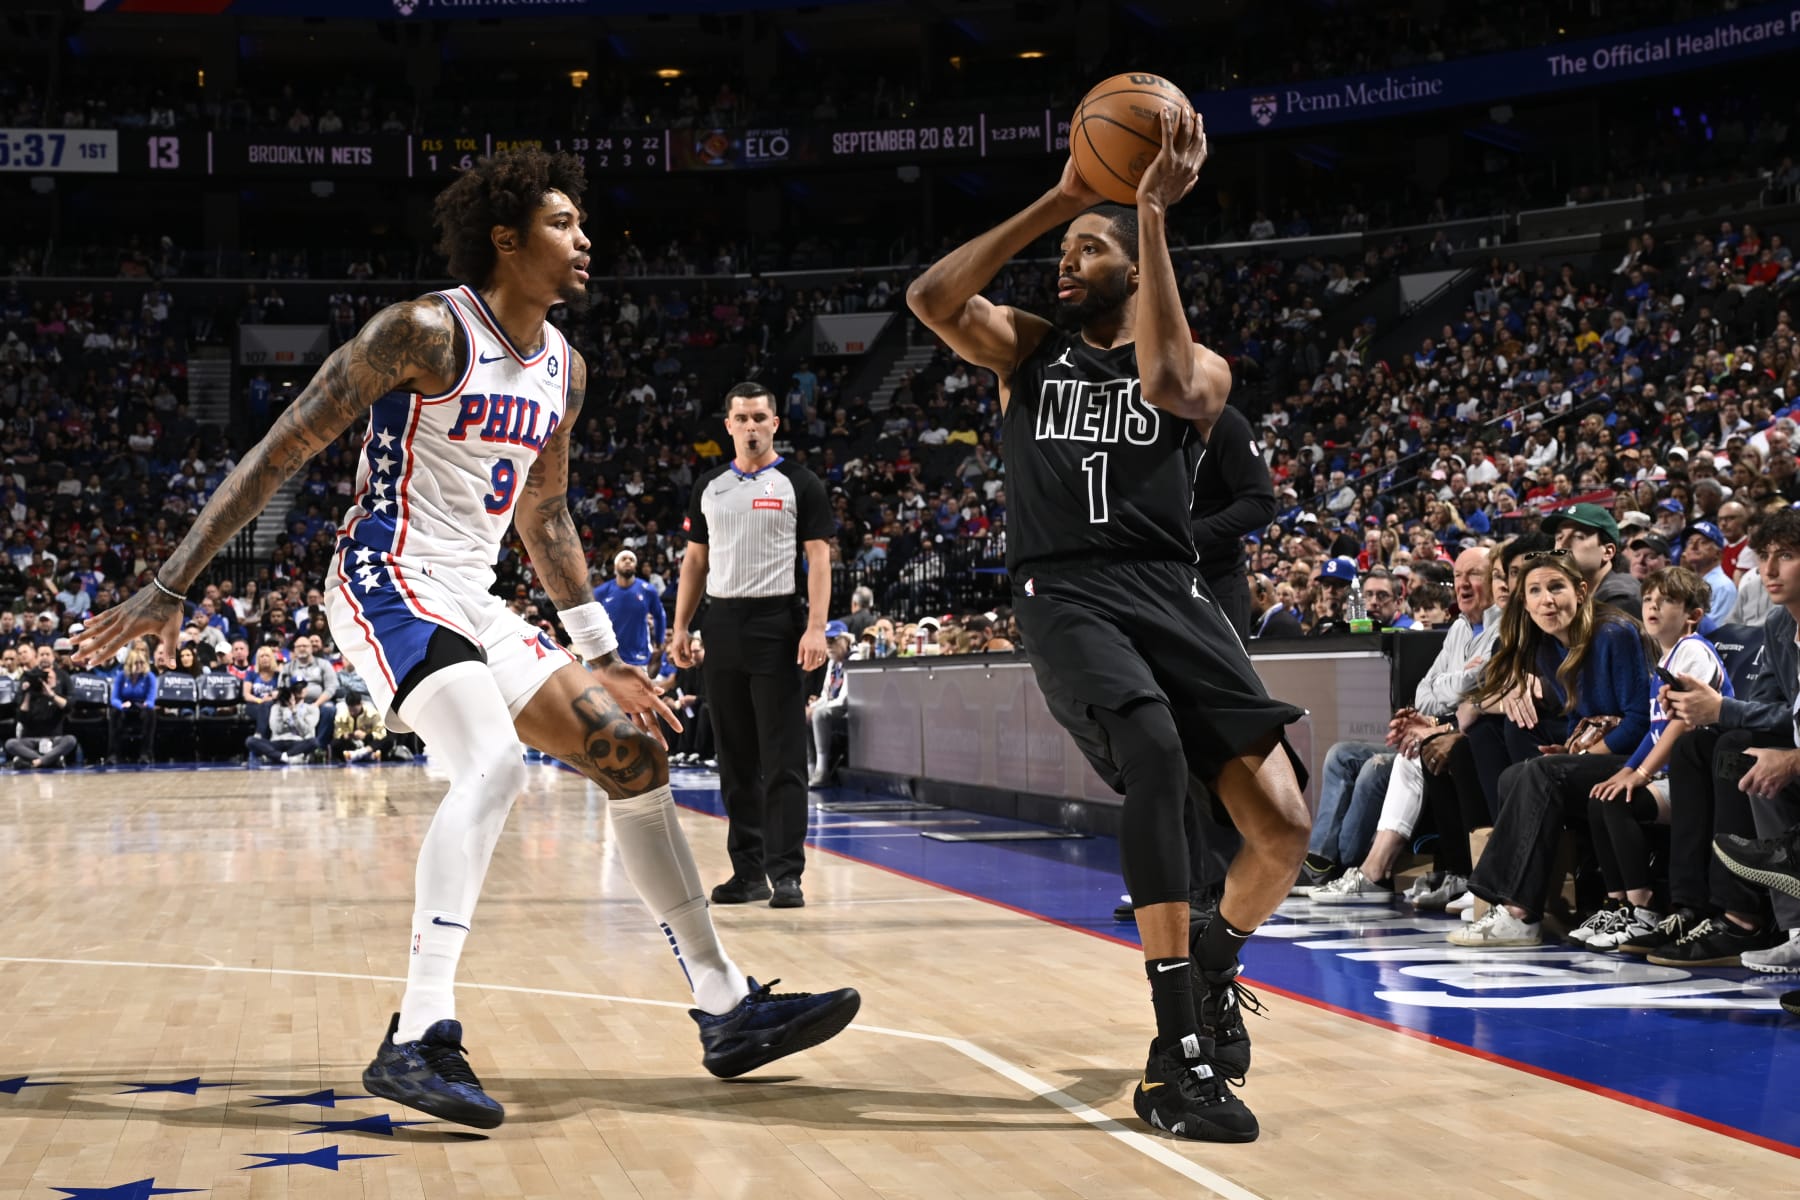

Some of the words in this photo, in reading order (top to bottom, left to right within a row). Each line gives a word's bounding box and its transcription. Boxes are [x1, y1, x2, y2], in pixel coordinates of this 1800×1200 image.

[1547, 54, 1587, 77] The
[1592, 37, 1671, 70] Official
[1675, 16, 1785, 57] Healthcare
[1285, 90, 1341, 113] Penn
[1344, 75, 1444, 108] Medicine
[832, 129, 917, 154] SEPTEMBER
[919, 127, 940, 149] 20
[942, 126, 956, 148] &
[958, 125, 974, 148] 21
[991, 127, 1017, 141] 1:23
[1018, 125, 1041, 140] PM
[79, 143, 106, 159] 1ST
[147, 135, 180, 169] 13
[248, 144, 324, 164] BROOKLYN
[331, 146, 373, 166] NETS
[421, 139, 444, 152] FLS
[454, 139, 479, 152] TOL
[572, 138, 589, 151] 33
[595, 138, 612, 151] 24
[623, 138, 632, 150] 9
[642, 138, 659, 150] 22
[746, 137, 789, 157] ELO
[428, 155, 437, 172] 1
[459, 154, 473, 170] 6
[599, 155, 608, 167] 2
[623, 154, 632, 167] 3
[1035, 377, 1160, 446] NETS
[484, 457, 518, 515] 9
[1081, 451, 1109, 524] 1
